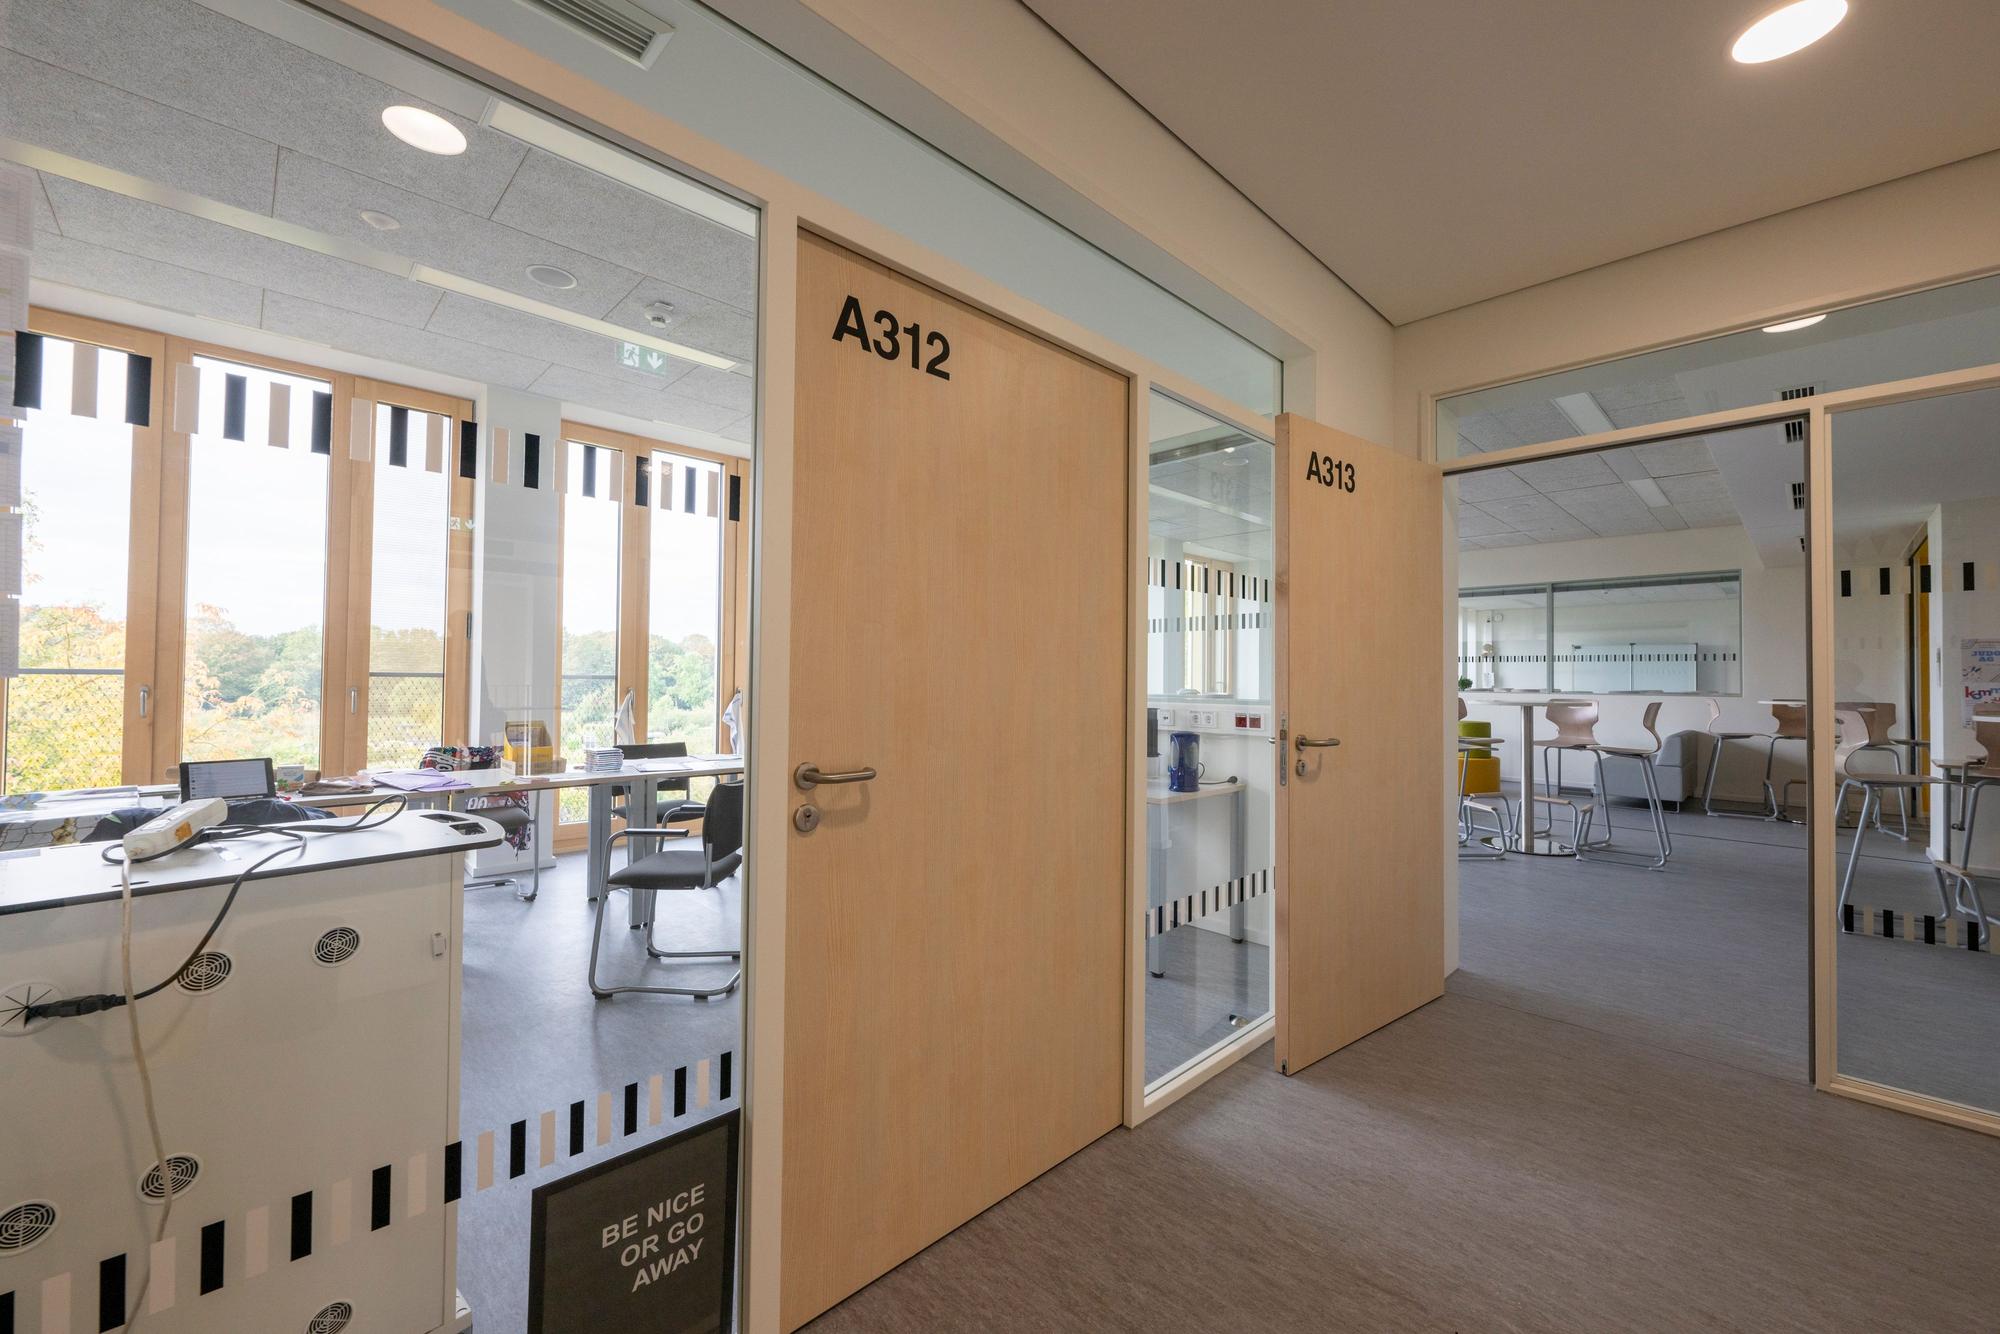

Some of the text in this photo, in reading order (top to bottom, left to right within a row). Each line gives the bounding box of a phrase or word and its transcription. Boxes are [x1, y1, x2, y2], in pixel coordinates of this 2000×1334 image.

[832, 295, 950, 381] A312
[1306, 451, 1355, 493] A313
[602, 1183, 705, 1248] BE NICE
[620, 1212, 704, 1267] OR GO
[631, 1238, 705, 1293] AWAY
